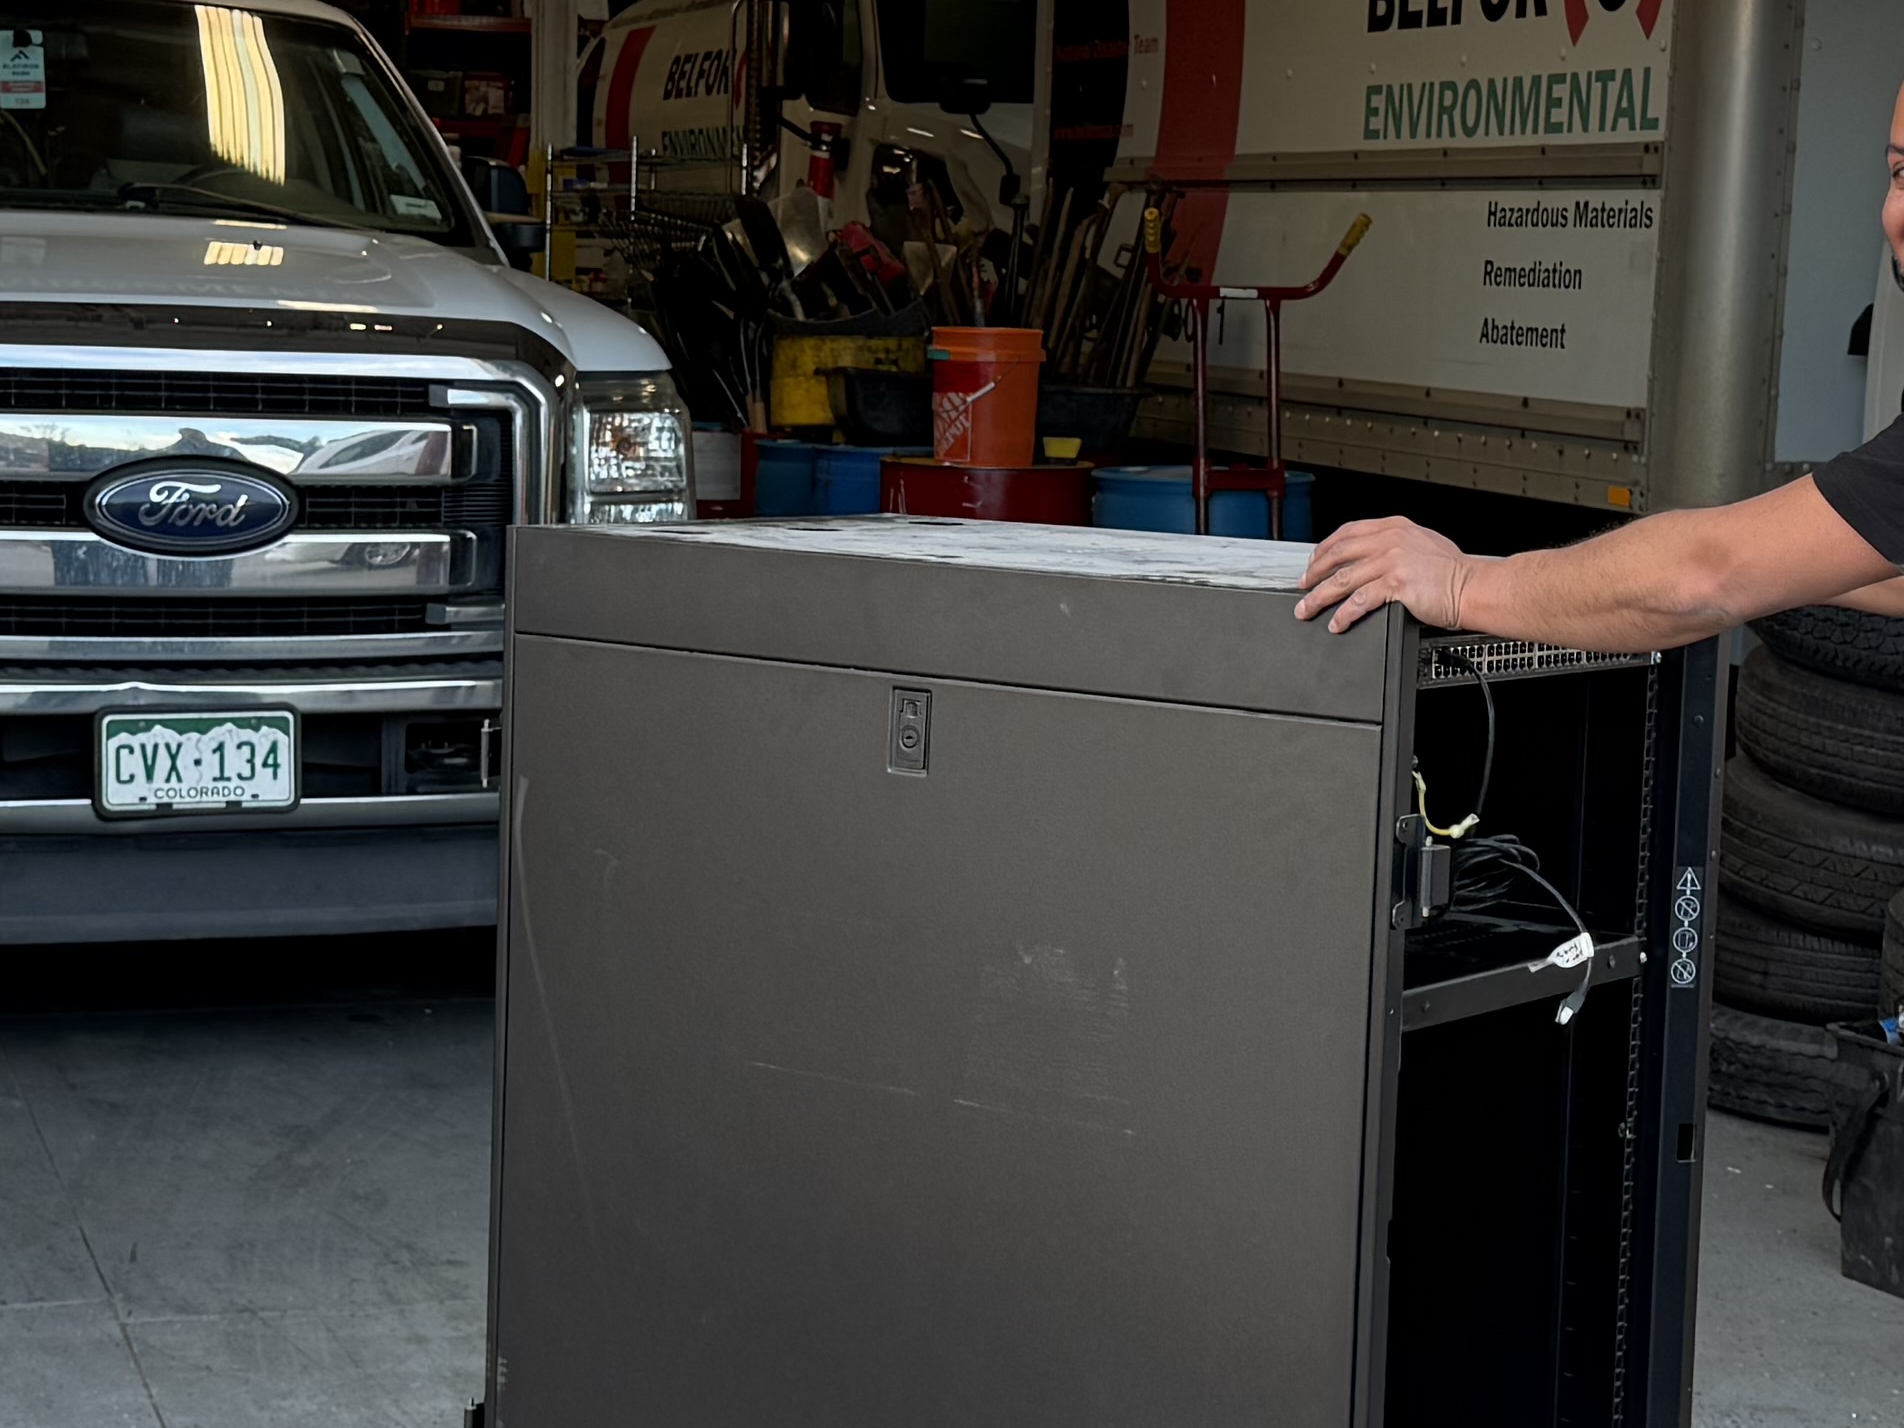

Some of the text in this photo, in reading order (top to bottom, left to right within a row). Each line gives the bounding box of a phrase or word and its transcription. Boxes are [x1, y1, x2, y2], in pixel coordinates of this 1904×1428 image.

[1134, 34, 1160, 55] Team
[1362, 66, 1660, 141] ENVIRONMENTAL
[1487, 199, 1654, 230] Hazardous Materials
[1483, 259, 1583, 290] Remediation
[1479, 317, 1566, 350] Abatement
[138, 480, 249, 527] Ford
[154, 785, 246, 800] COLORADO
